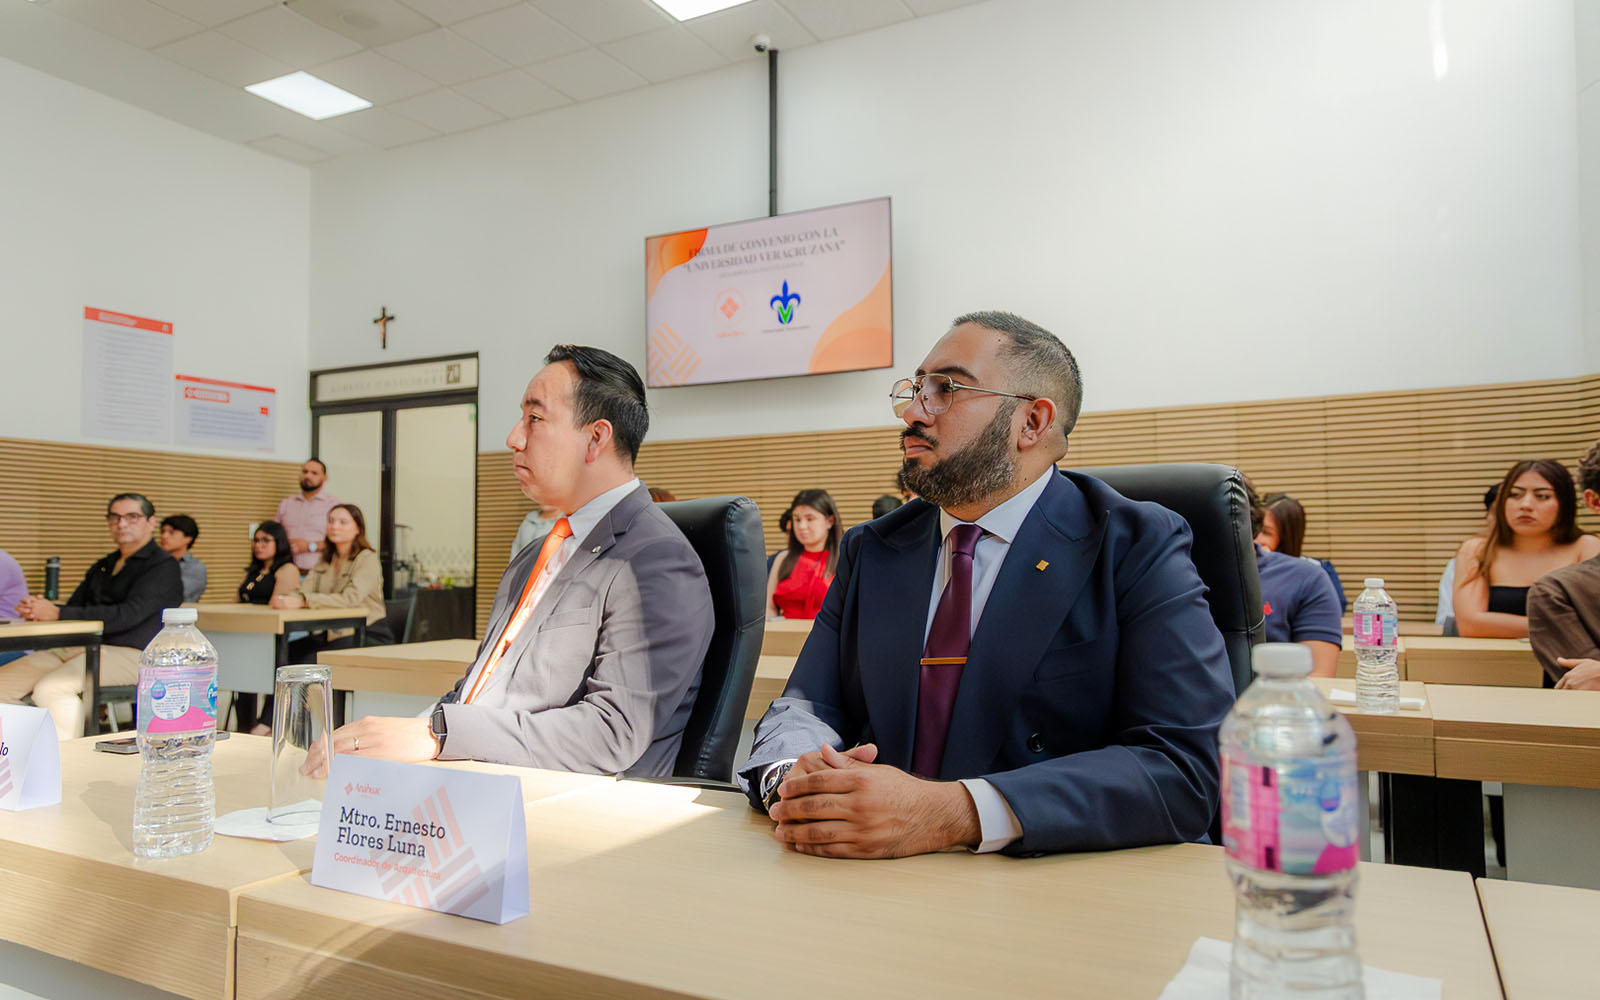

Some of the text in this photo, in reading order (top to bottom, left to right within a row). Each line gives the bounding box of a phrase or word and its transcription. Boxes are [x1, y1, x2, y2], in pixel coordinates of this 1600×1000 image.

[689, 227, 838, 258] FIRMA DE CONVENIO CON LA
[340, 806, 446, 839] Mtro. Ernesto
[337, 826, 426, 858] Flores Luna
[334, 851, 441, 880] Coordinador de Arquitectura
